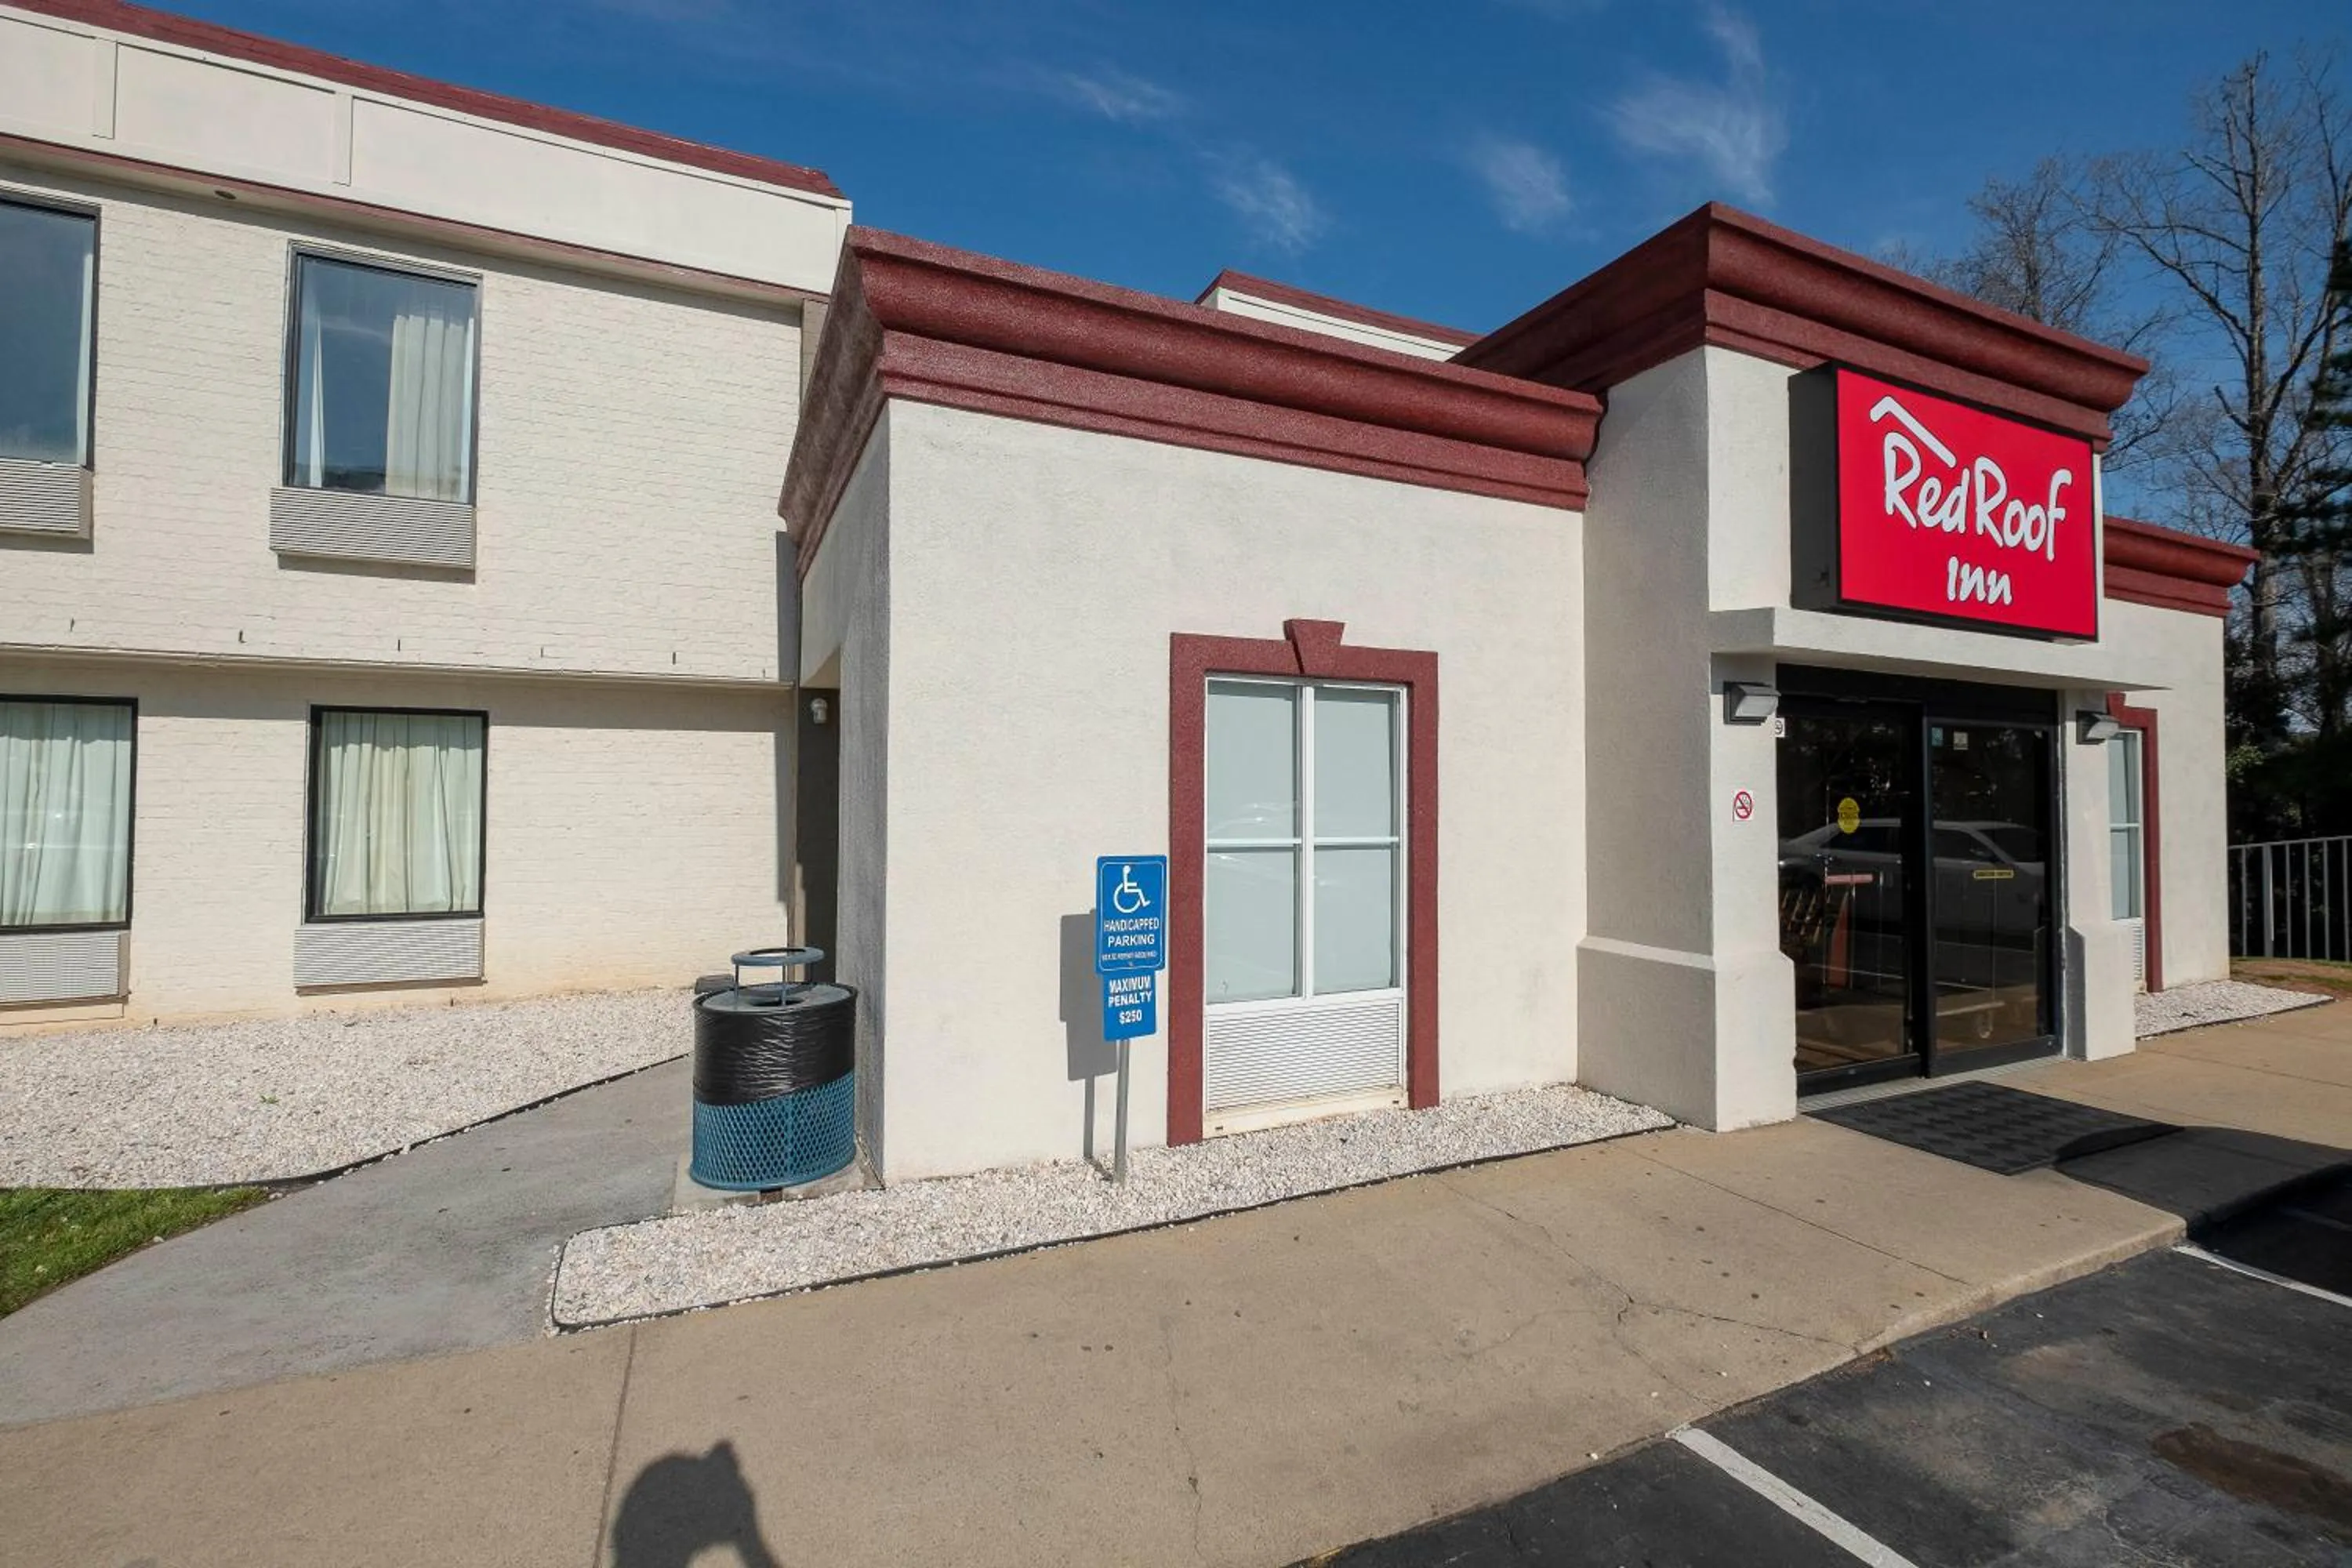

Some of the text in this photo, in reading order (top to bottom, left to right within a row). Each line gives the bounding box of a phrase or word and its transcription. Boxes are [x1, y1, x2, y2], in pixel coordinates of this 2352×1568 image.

[1884, 432, 2072, 561] Red Roof
[1947, 556, 2013, 605] Inn
[1103, 917, 1160, 931] HANDICAPPED
[1108, 935, 1155, 947] PARKING
[1109, 976, 1151, 993] MAXIMUM
[1108, 991, 1152, 1007] PENALTY
[1119, 1010, 1142, 1025] $250
